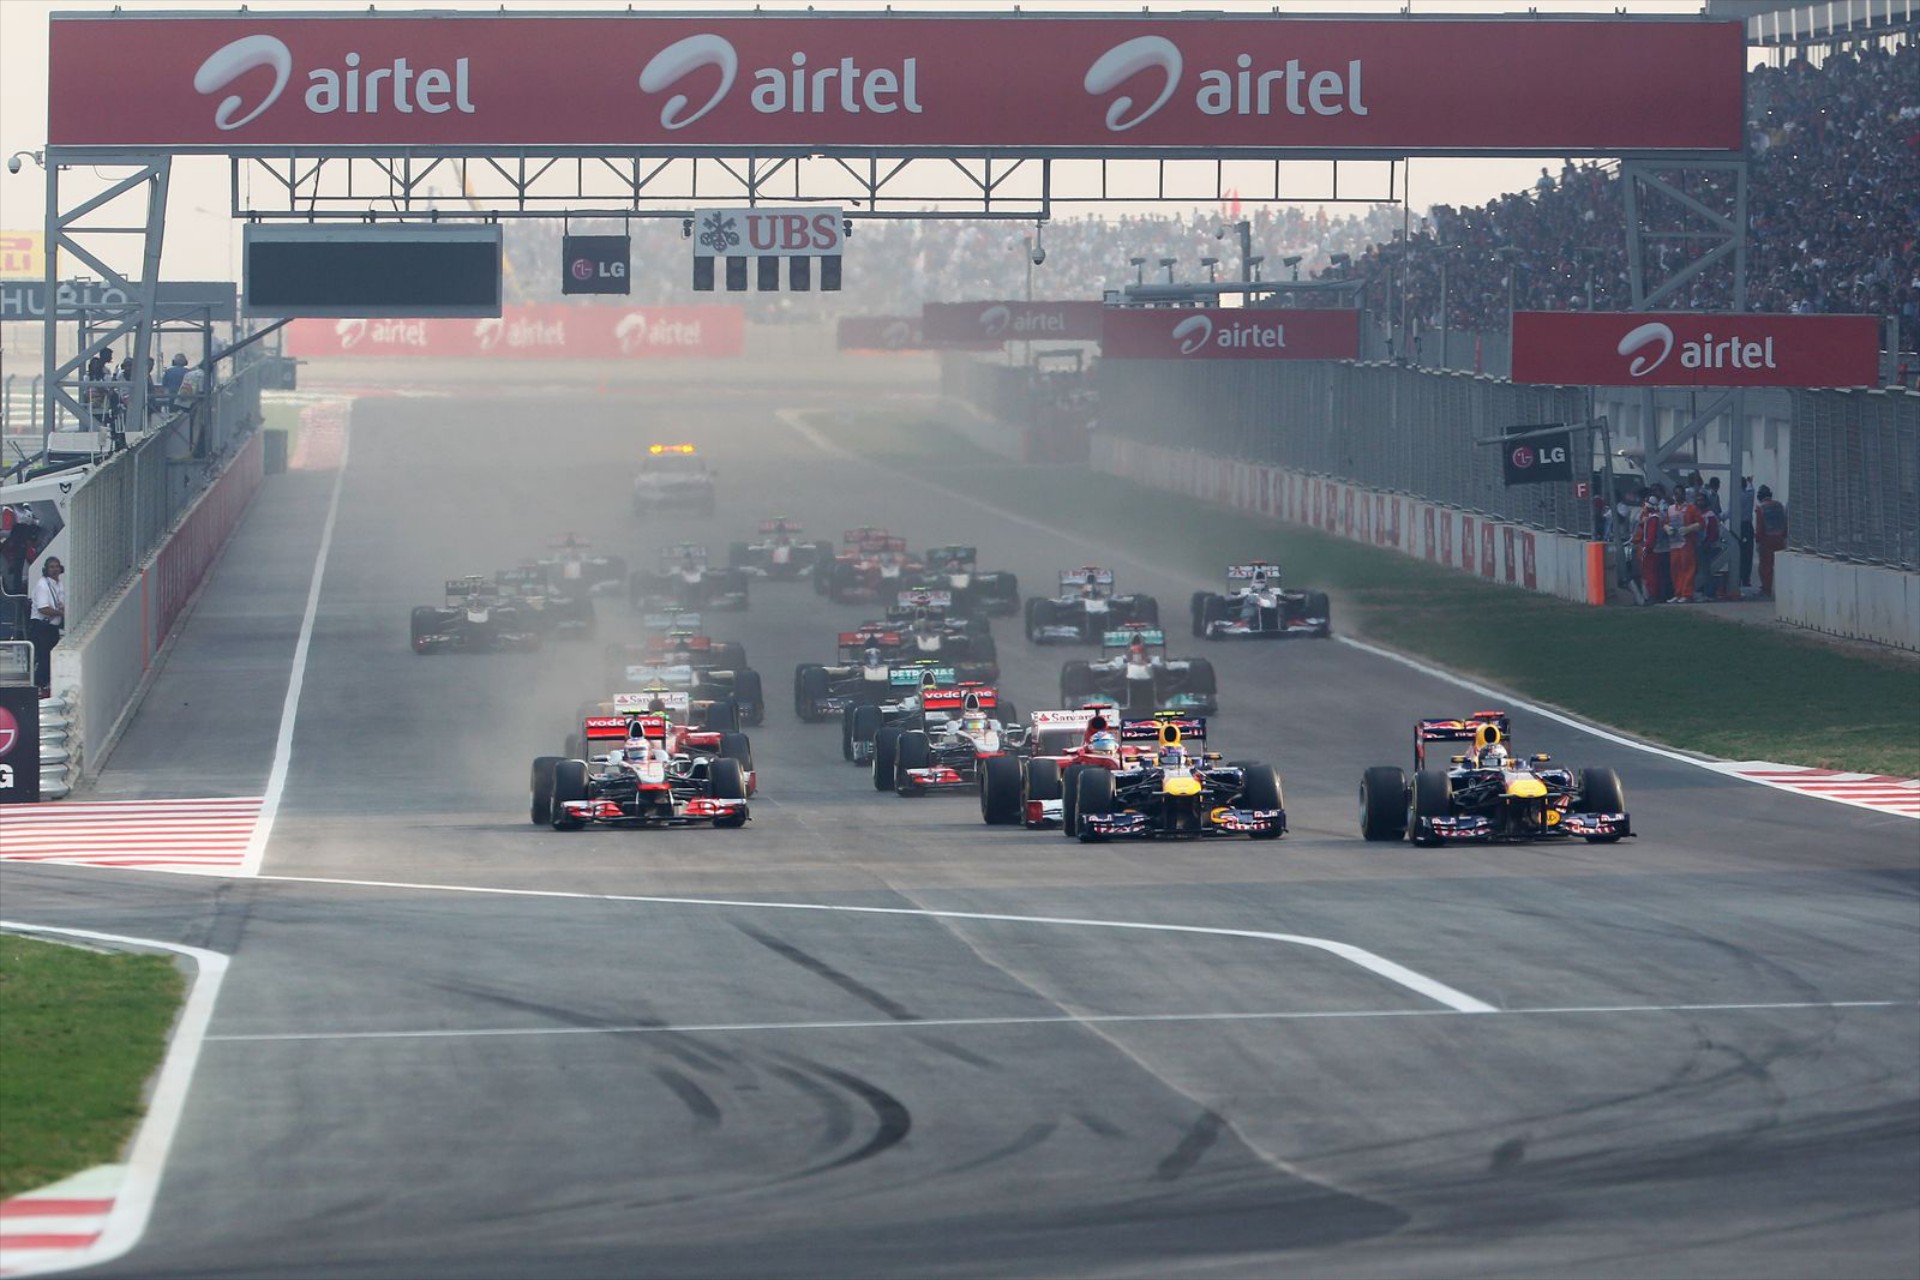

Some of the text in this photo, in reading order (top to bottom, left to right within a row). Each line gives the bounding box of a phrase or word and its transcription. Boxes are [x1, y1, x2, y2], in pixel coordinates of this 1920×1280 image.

[305, 52, 475, 114] airtel
[751, 51, 923, 114] airtel
[1196, 53, 1368, 116] airtel
[746, 213, 838, 250] UBS
[599, 261, 625, 278] LG
[507, 317, 566, 346] airtel
[650, 318, 701, 345] airtel
[1013, 311, 1066, 332] airtel
[1217, 322, 1286, 348] airtel
[1680, 333, 1776, 369] airtel
[1540, 448, 1566, 464] LG
[1577, 483, 1587, 498] F
